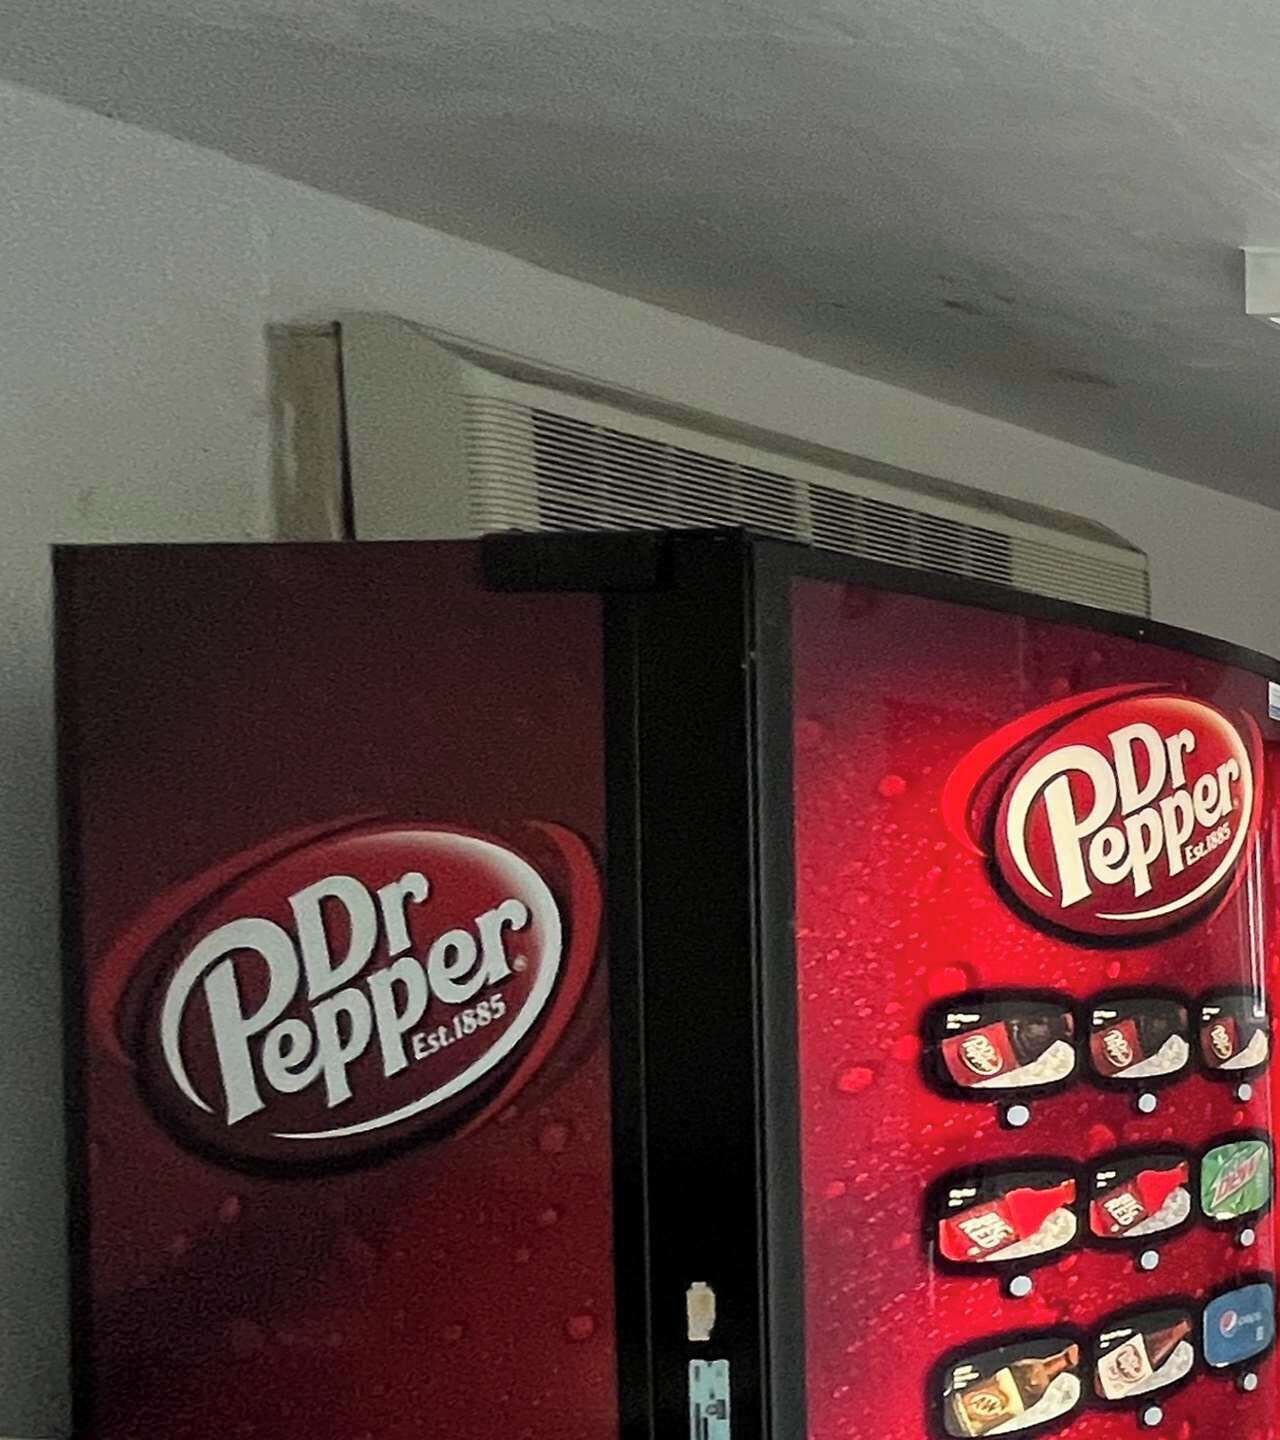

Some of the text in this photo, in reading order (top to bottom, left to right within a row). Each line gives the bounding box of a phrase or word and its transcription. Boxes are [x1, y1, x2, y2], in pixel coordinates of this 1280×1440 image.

[1006, 744, 1240, 908] Pepper
[1108, 721, 1196, 818] Dr
[286, 871, 429, 1001] Dr
[160, 897, 530, 1126] Pepper
